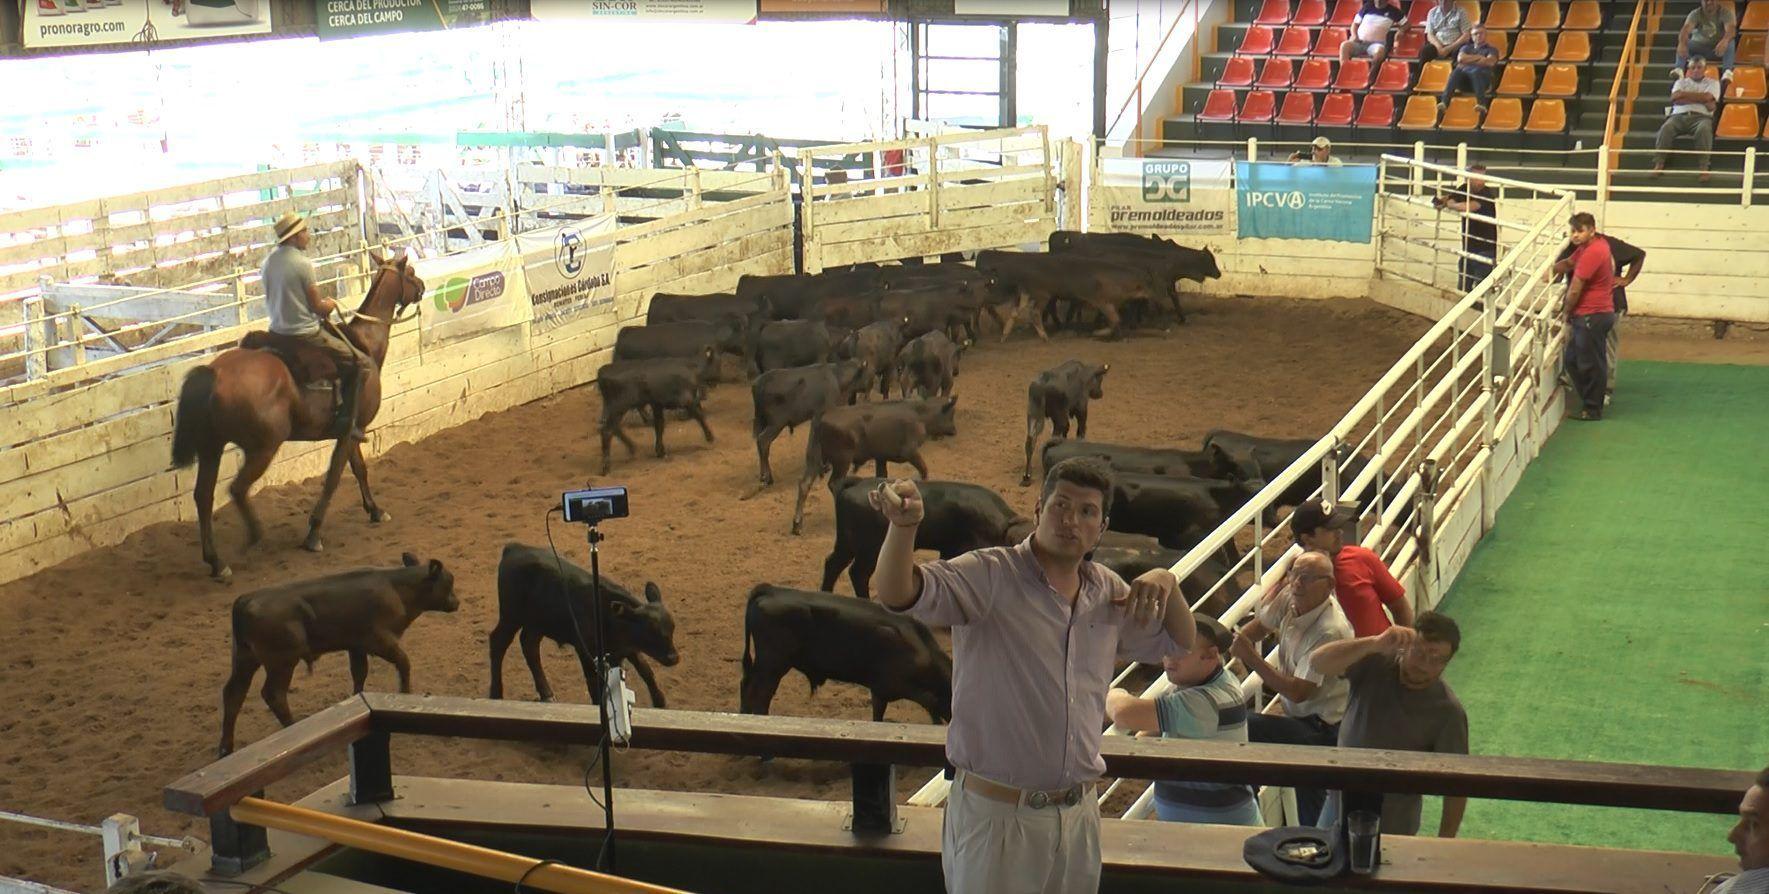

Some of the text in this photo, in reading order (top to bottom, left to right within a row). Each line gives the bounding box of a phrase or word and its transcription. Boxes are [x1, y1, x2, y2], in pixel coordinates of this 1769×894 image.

[327, 1, 355, 13] CERCA
[356, 0, 372, 11] DEL
[592, 1, 637, 10] SIN-COR
[328, 10, 403, 27] CERCA DEL CAMPO
[40, 21, 125, 38] pronoragro.com
[1145, 164, 1188, 174] GRUPO
[1111, 209, 1224, 222] premoldeados
[473, 275, 501, 289] Campo
[475, 286, 501, 301] Directo
